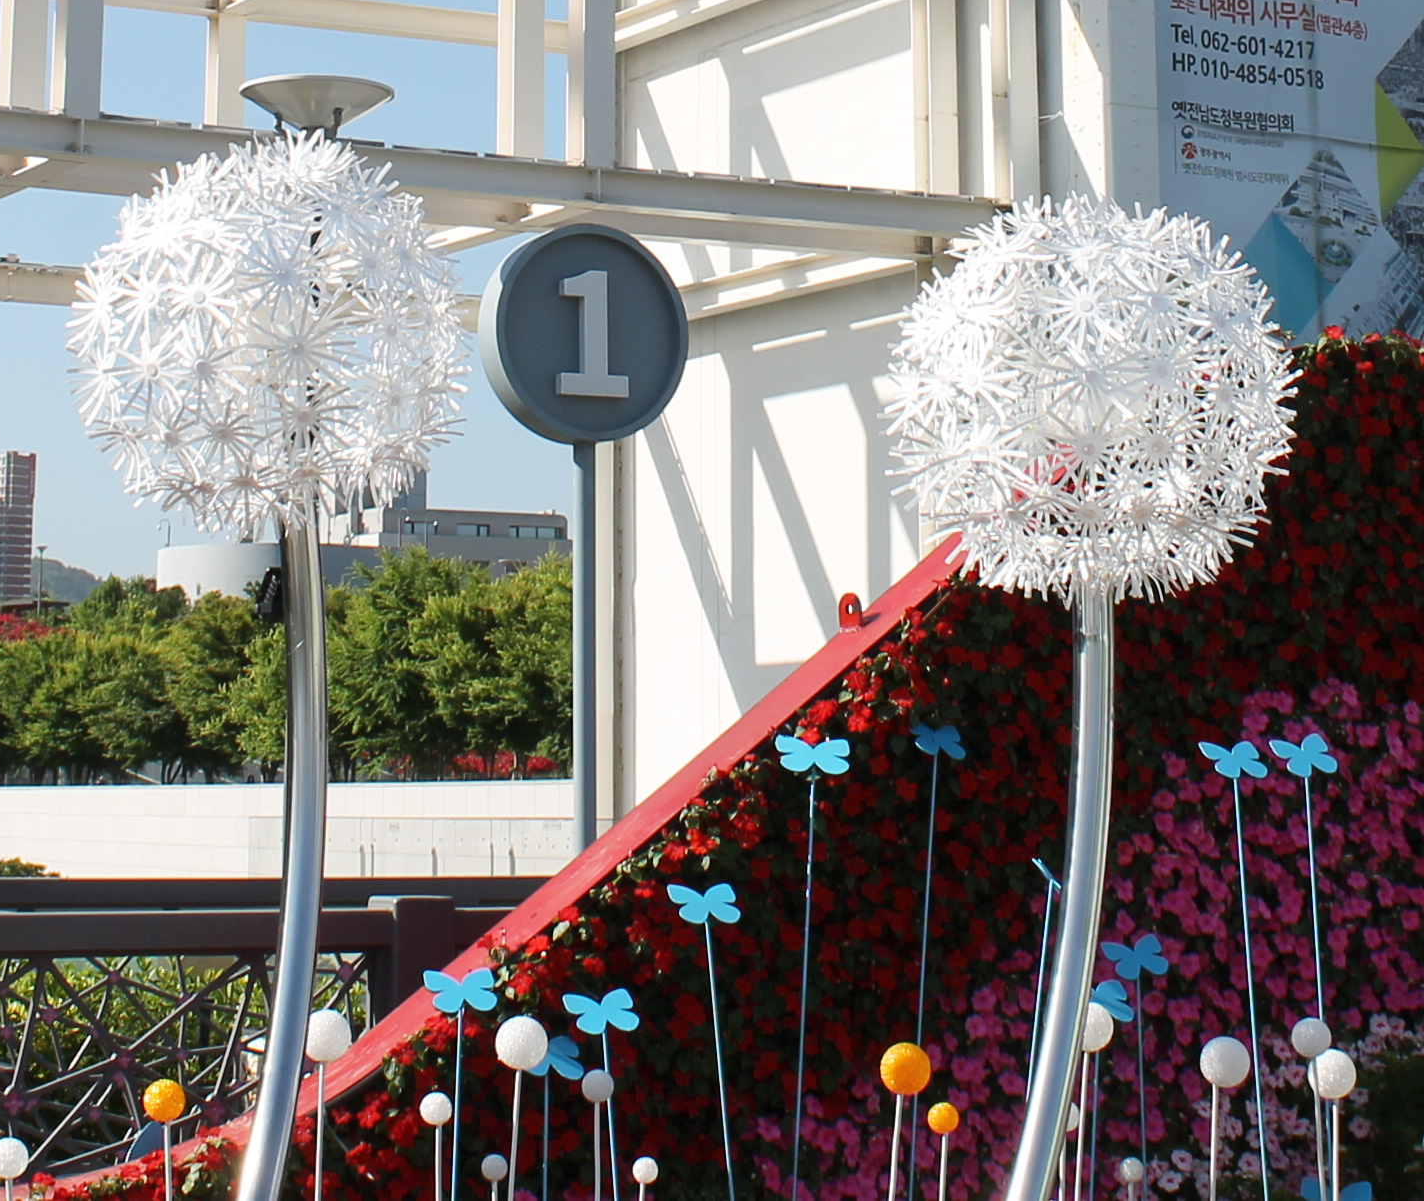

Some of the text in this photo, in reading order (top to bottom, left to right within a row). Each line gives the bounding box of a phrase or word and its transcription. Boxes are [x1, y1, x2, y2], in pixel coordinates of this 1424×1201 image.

[1201, 34, 1315, 60] 062-601-4217
[1171, 101, 1294, 132] 옛전남도청복원협의회
[556, 270, 629, 397] 1
